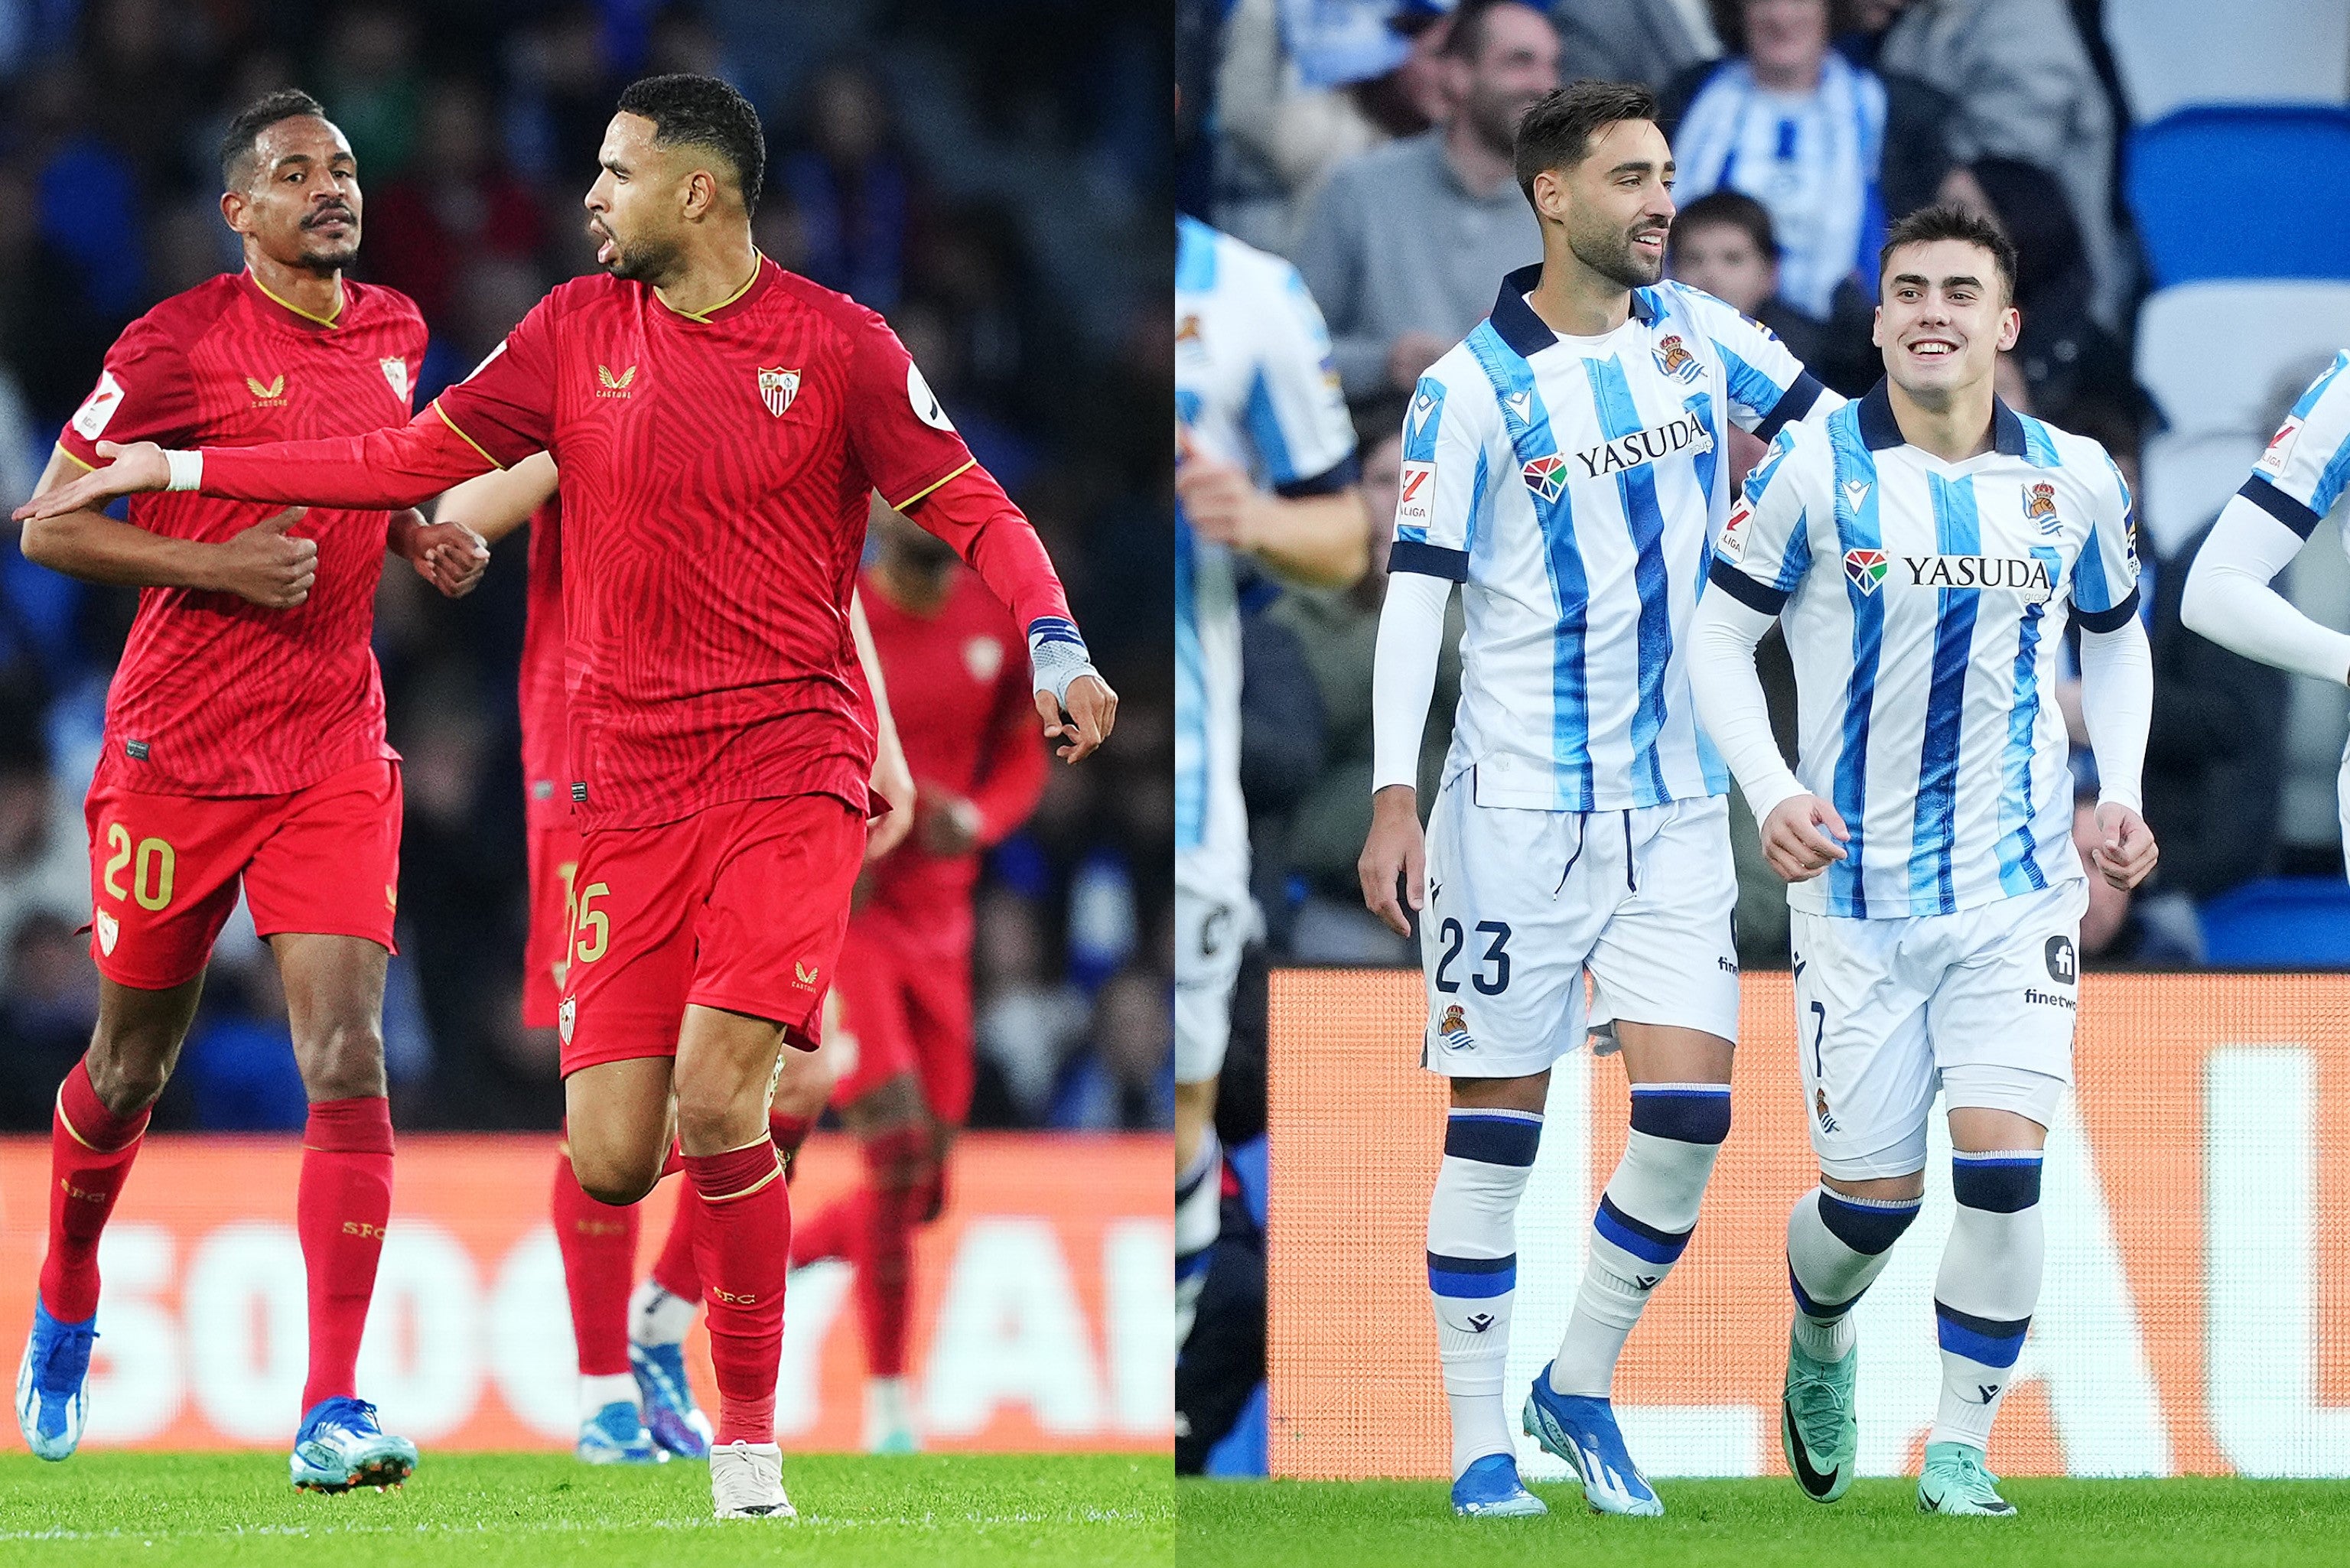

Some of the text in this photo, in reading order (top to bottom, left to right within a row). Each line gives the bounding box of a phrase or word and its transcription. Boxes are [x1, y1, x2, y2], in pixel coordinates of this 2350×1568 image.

[1576, 412, 1707, 479] YASUDA
[1902, 557, 2050, 590] YASUDA
[104, 822, 175, 912] 20
[1435, 917, 1512, 996] 23
[1810, 1000, 1826, 1078] 7
